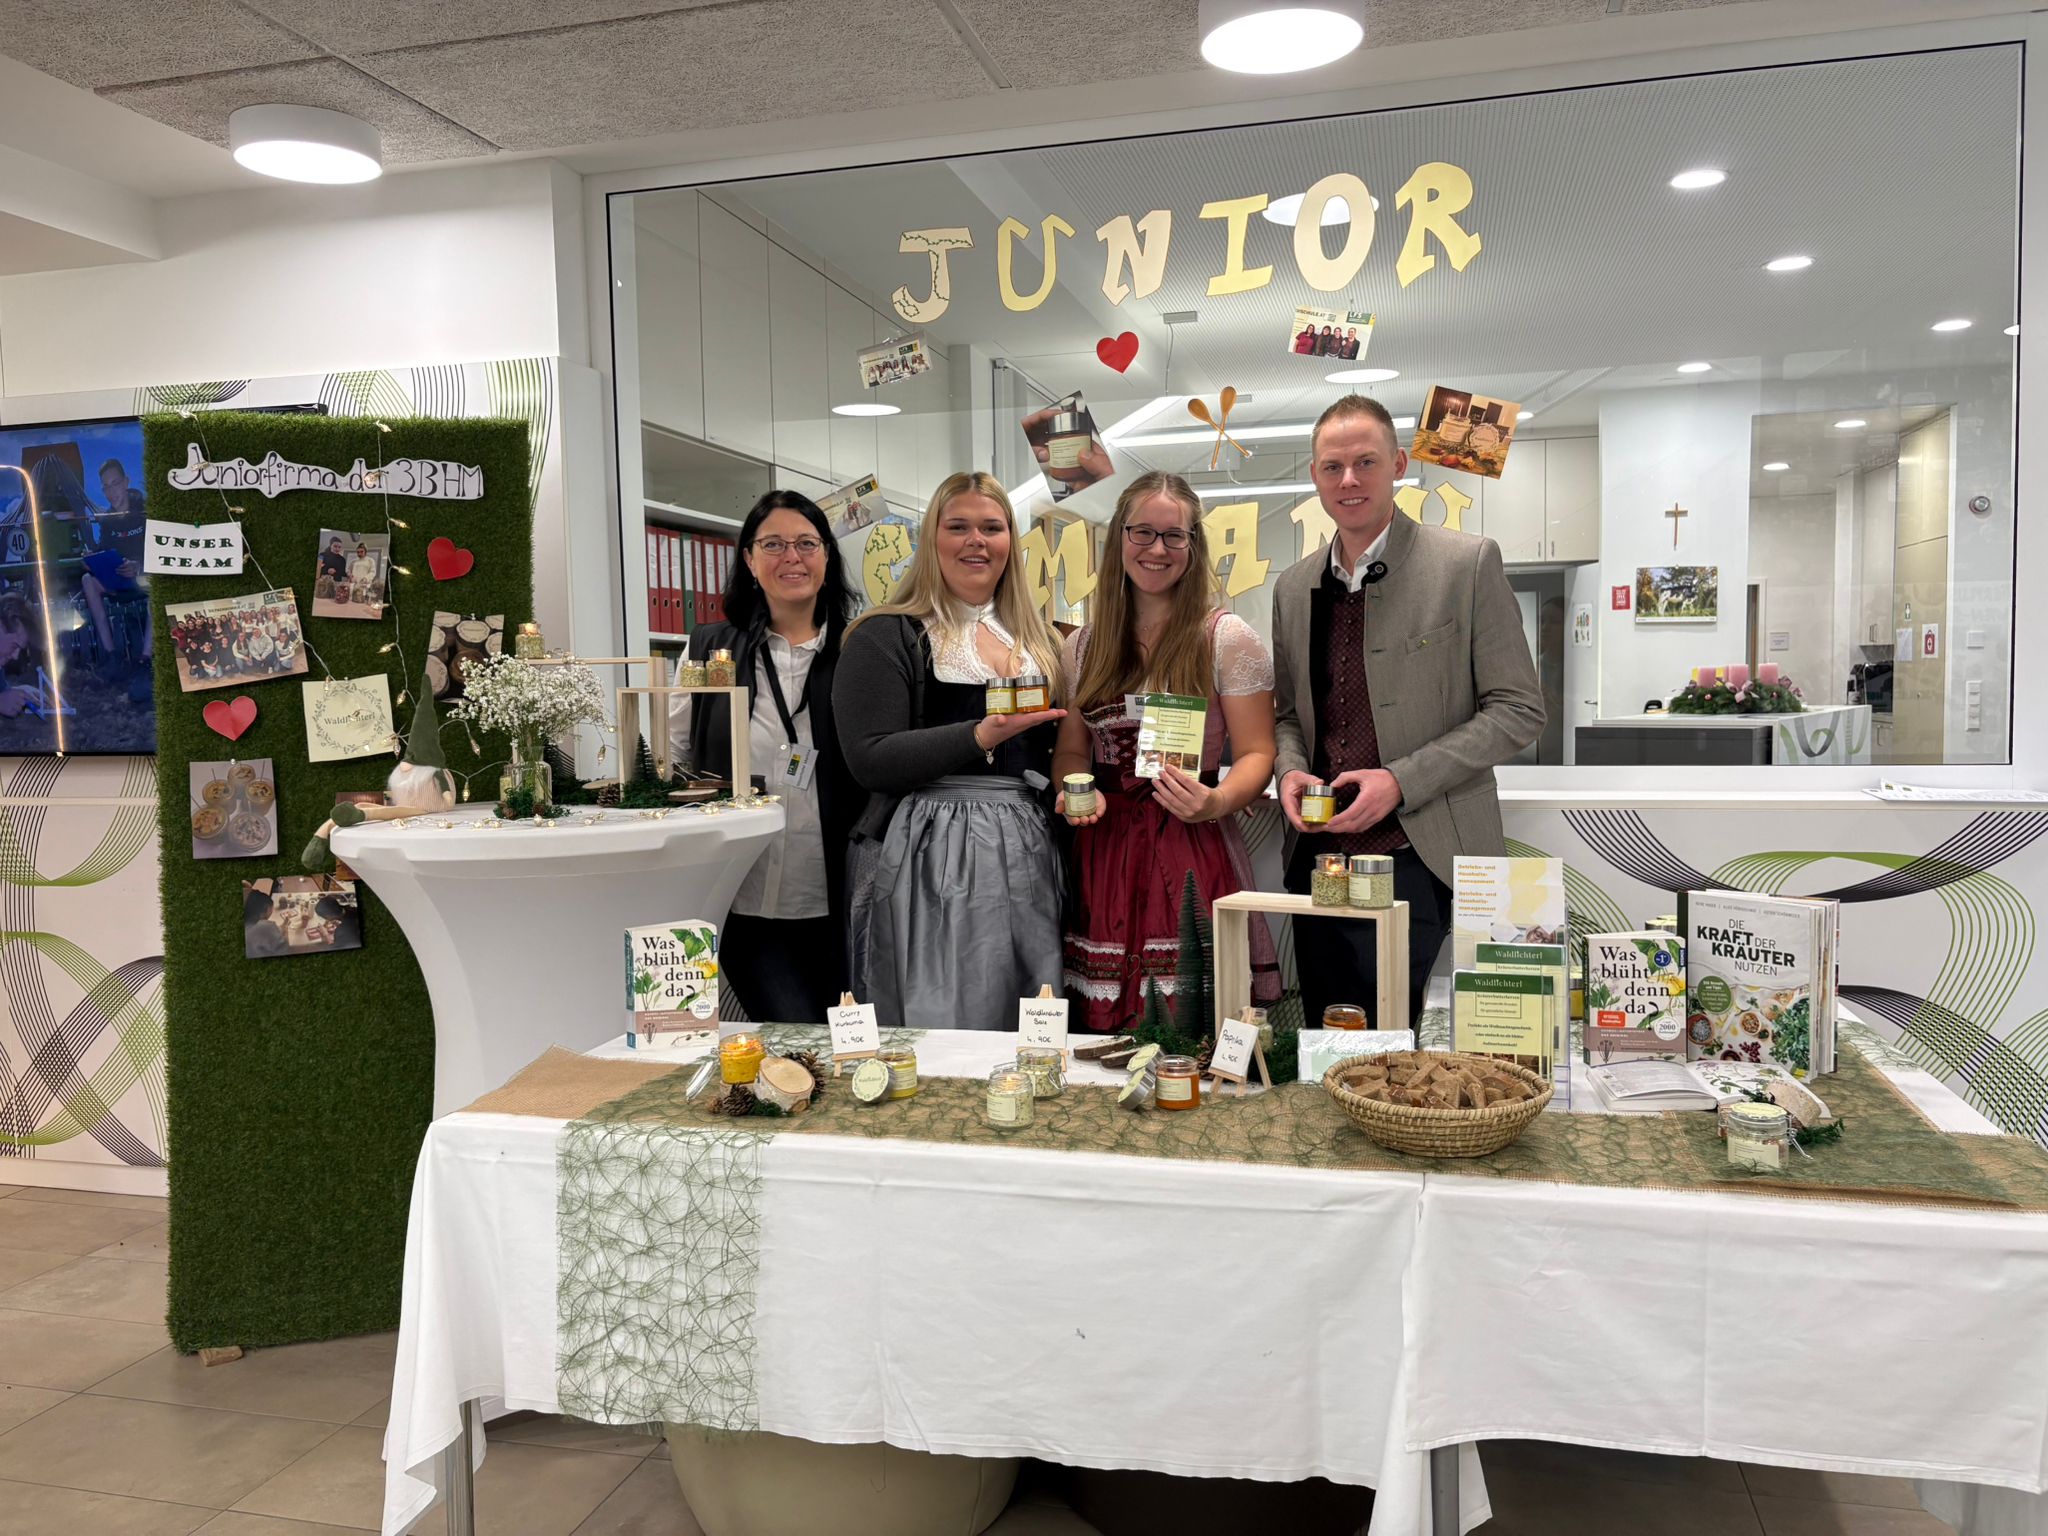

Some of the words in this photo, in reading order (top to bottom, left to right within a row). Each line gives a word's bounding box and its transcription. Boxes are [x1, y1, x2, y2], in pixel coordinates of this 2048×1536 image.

[892, 161, 1482, 323] JUNIOR
[171, 446, 338, 495] Juniorfirma
[11, 533, 25, 551] 40
[152, 535, 235, 549] UNSER
[158, 556, 234, 568] TEAM
[1728, 919, 1745, 930] DIE
[642, 936, 676, 950] Was
[1697, 925, 1754, 946] KRAFT
[1754, 937, 1777, 950] DER
[644, 951, 687, 966] blüht
[1599, 946, 1637, 961] Was
[1712, 942, 1796, 968] KRÄUTER
[665, 968, 705, 982] denn
[1601, 963, 1650, 979] blüht
[1734, 961, 1778, 976] NUTZEN
[1624, 981, 1671, 997] denn
[839, 1010, 860, 1018] Curry
[1659, 1023, 1677, 1031] 2000
